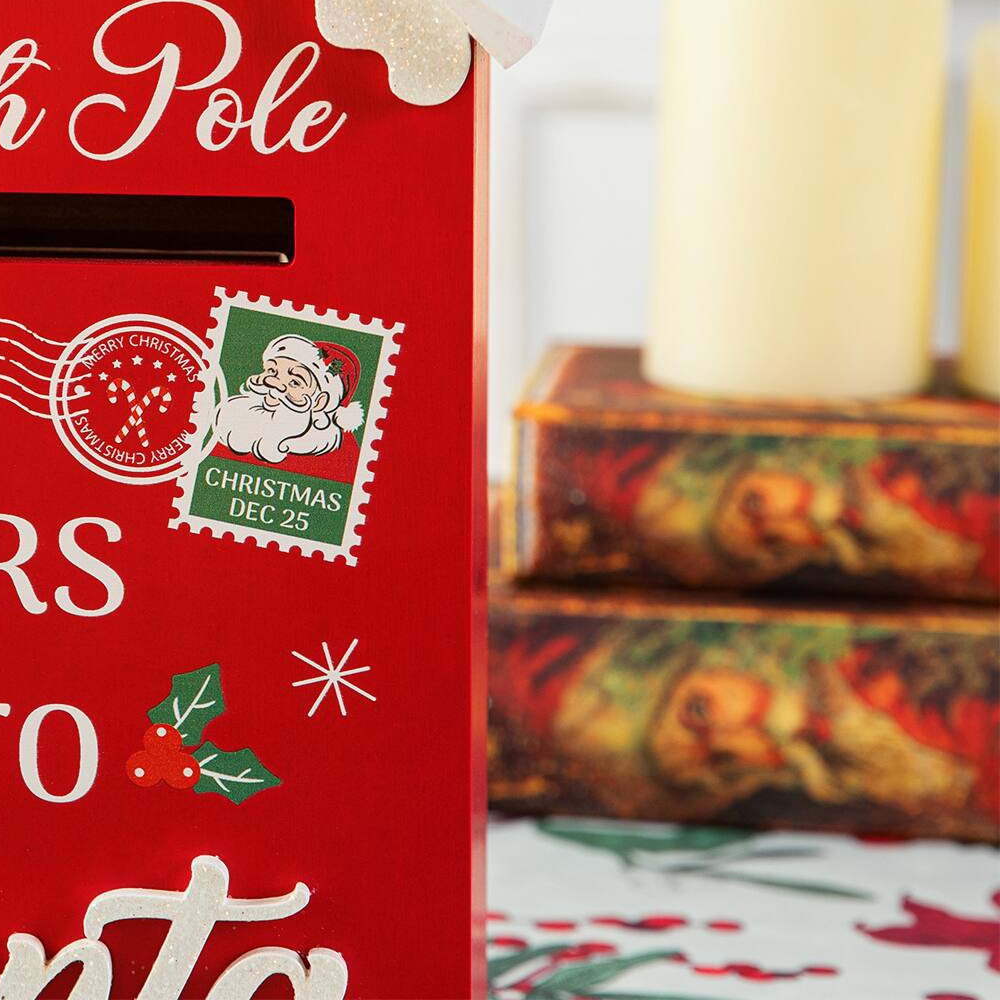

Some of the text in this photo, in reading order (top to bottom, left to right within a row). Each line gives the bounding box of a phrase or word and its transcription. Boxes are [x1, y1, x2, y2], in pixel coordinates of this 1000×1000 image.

[82, 334, 199, 383] MERRY CHRISTMAS
[75, 416, 190, 465] MERRY CHRISTMAS
[205, 467, 342, 512] CHRISTMAS
[229, 497, 310, 531] DEC 25
